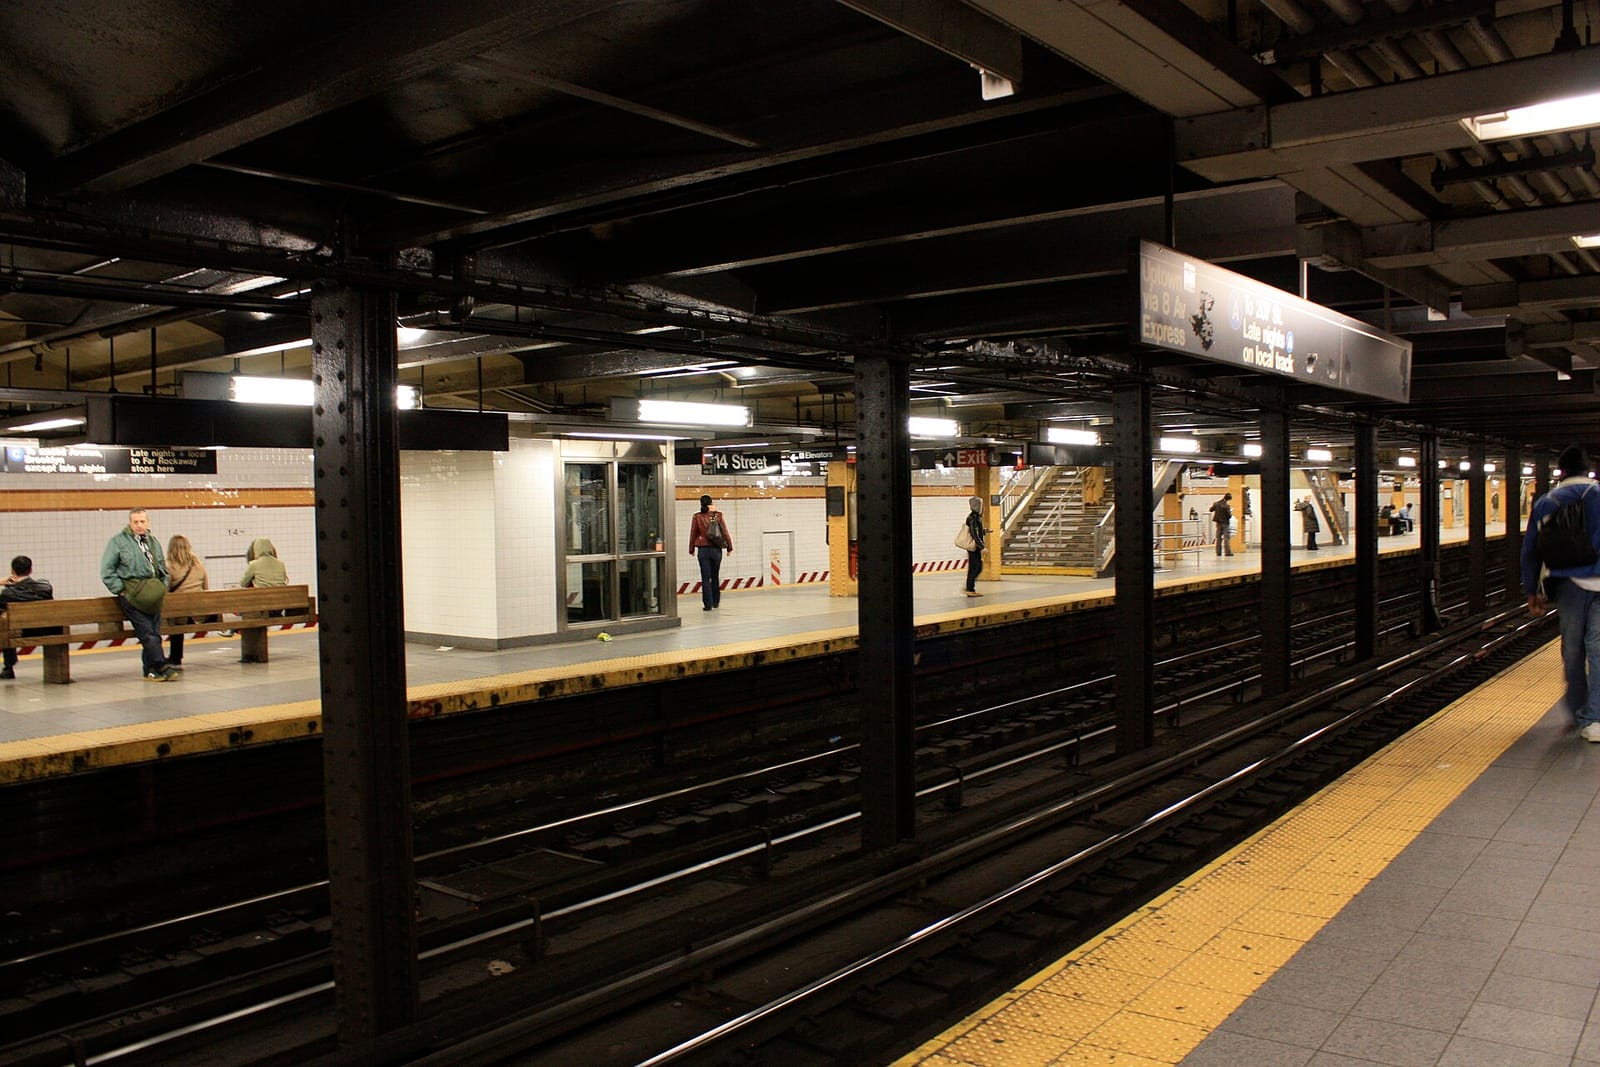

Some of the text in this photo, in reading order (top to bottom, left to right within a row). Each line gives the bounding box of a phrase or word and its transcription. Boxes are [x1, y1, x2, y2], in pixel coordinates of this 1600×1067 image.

[1143, 258, 1183, 292] Uptown
[1143, 290, 1187, 319] via 8 Av
[1143, 313, 1186, 346] Express
[1243, 317, 1261, 342] Late
[1263, 325, 1286, 350] nights
[1243, 345, 1295, 374] on local track
[24, 455, 65, 466] Brooklyn
[130, 448, 149, 457] Late
[151, 449, 176, 459] nights
[956, 449, 987, 465] Exit
[24, 464, 106, 474] except late nights
[131, 457, 198, 467] to Far Rockaway
[131, 465, 175, 474] stops here
[714, 454, 728, 469] 14
[732, 454, 768, 470] Street
